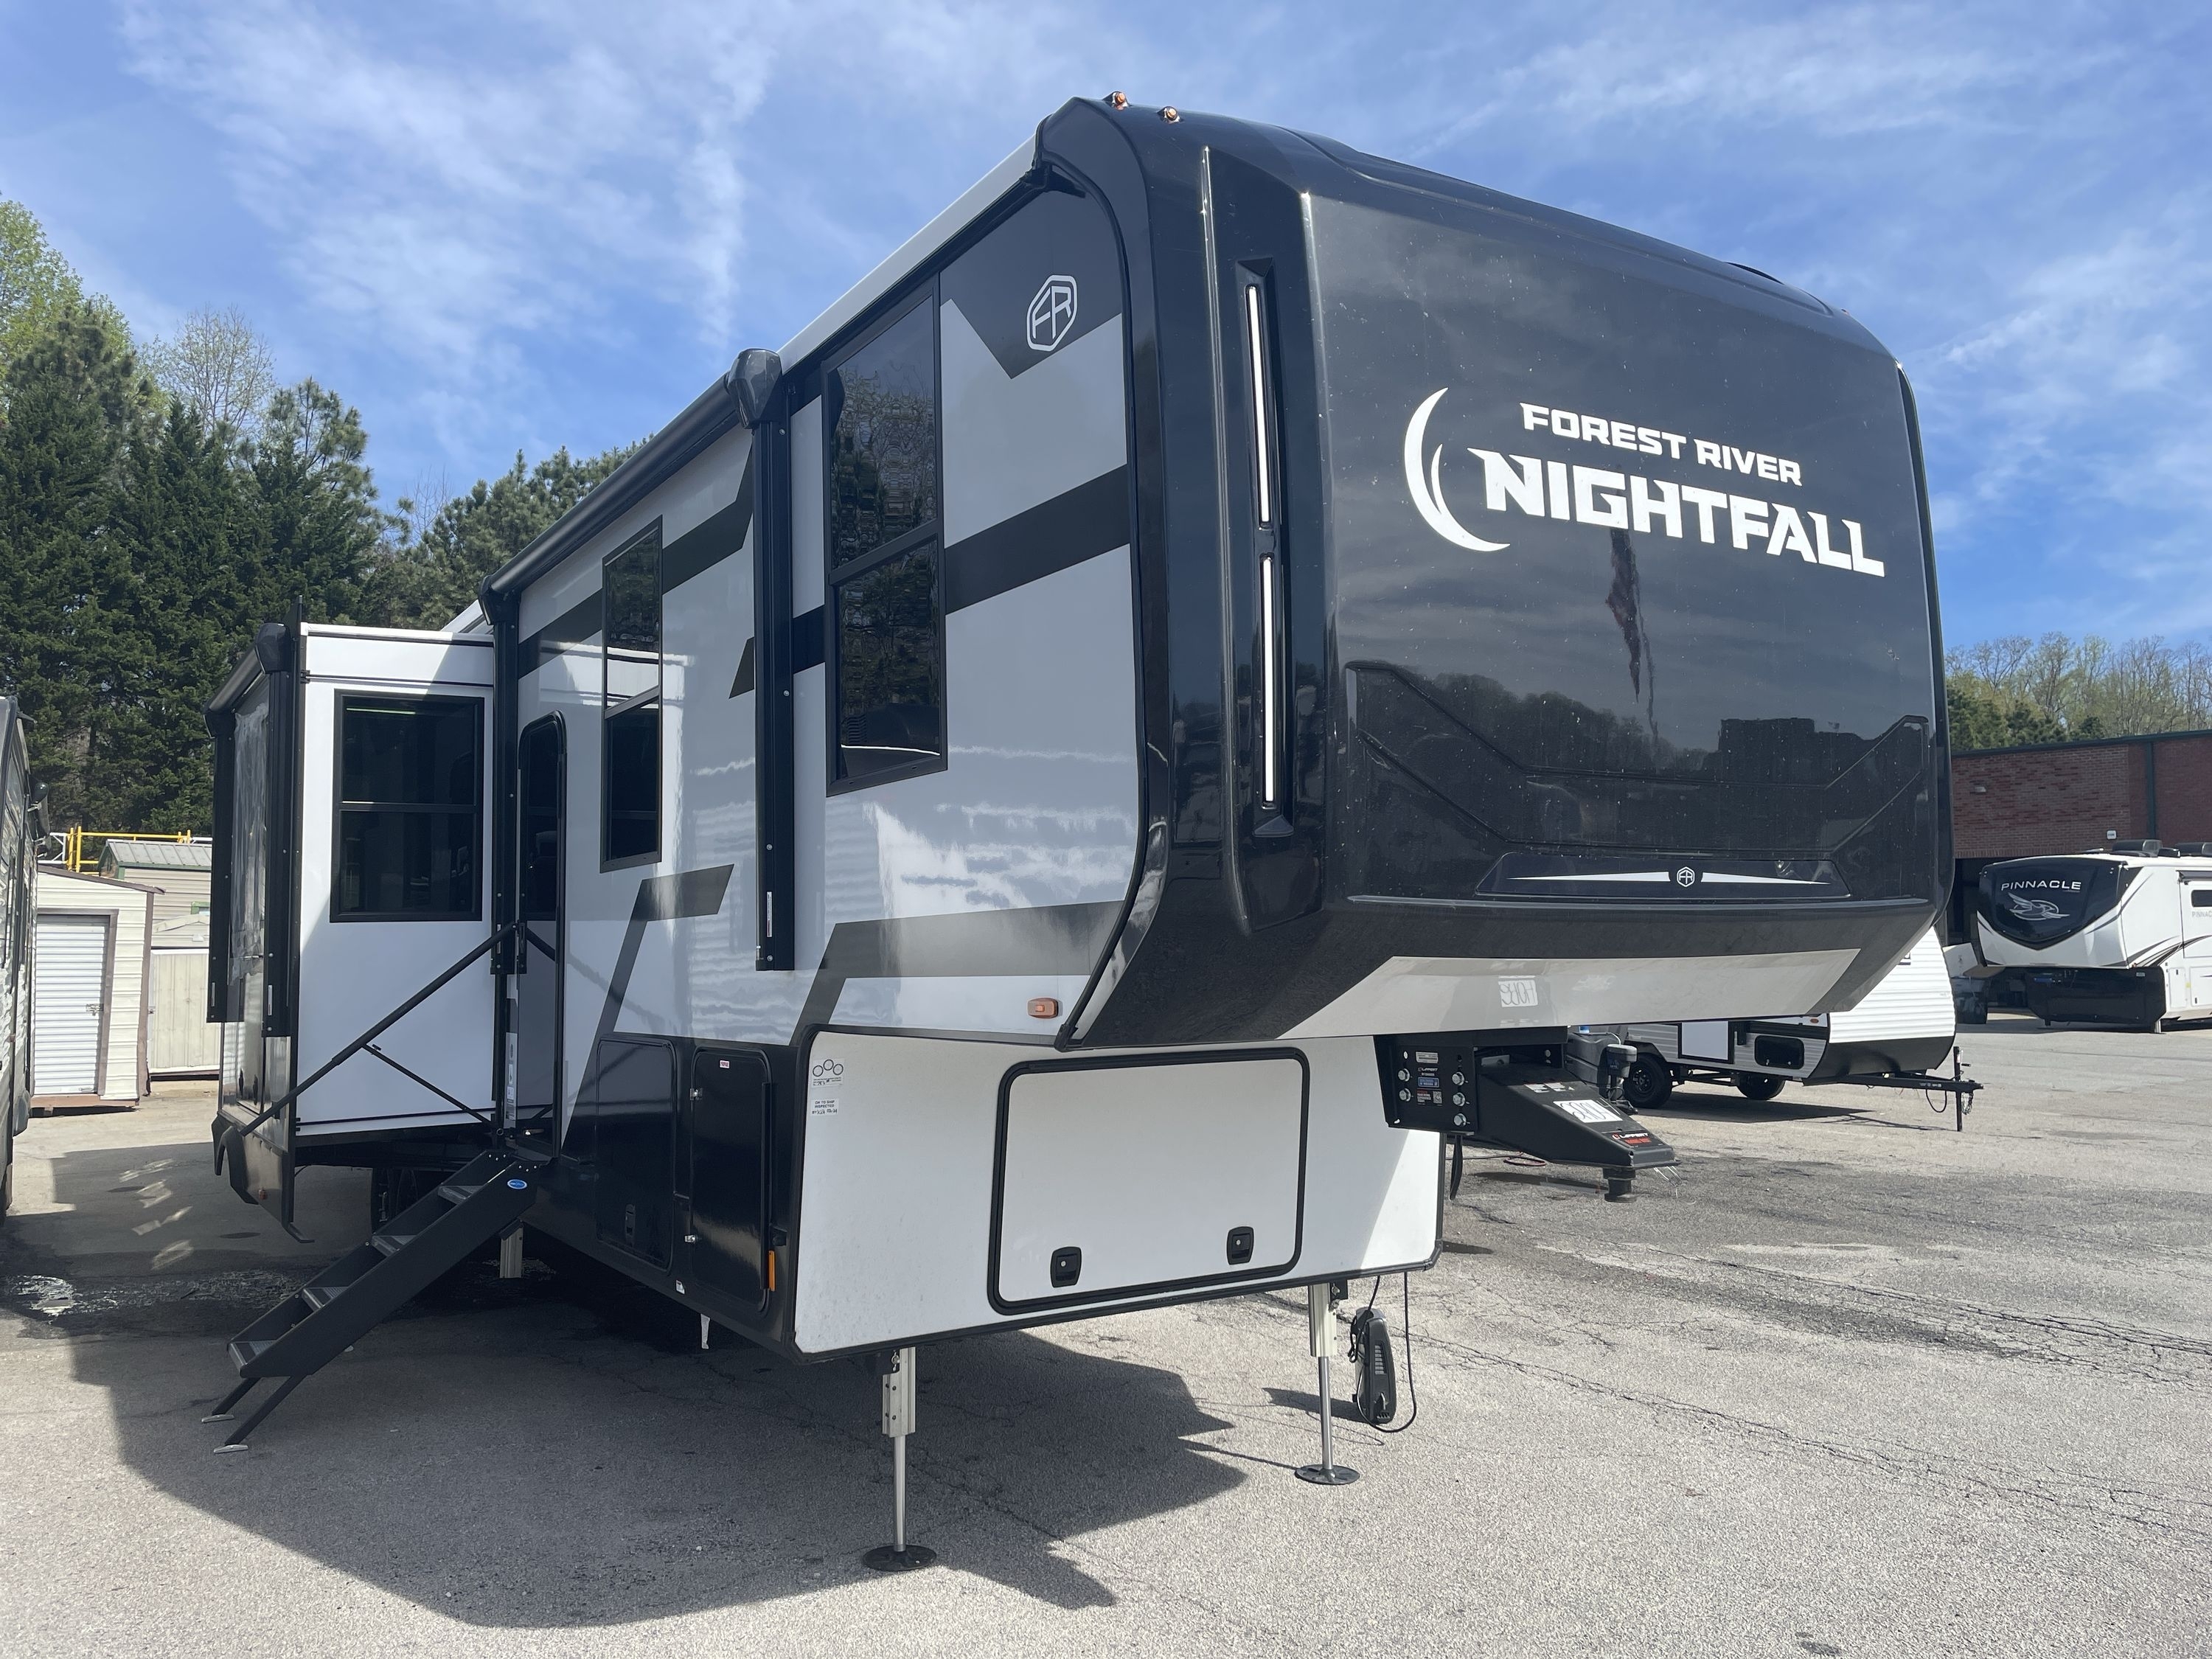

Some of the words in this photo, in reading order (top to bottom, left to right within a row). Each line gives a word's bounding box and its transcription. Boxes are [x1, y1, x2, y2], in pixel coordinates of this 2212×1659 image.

[1519, 402, 1687, 459] FOREST
[1694, 438, 1802, 487] RIVER
[1467, 447, 1885, 577] NIGHTFALL
[2000, 880, 2081, 891] PINNACLE
